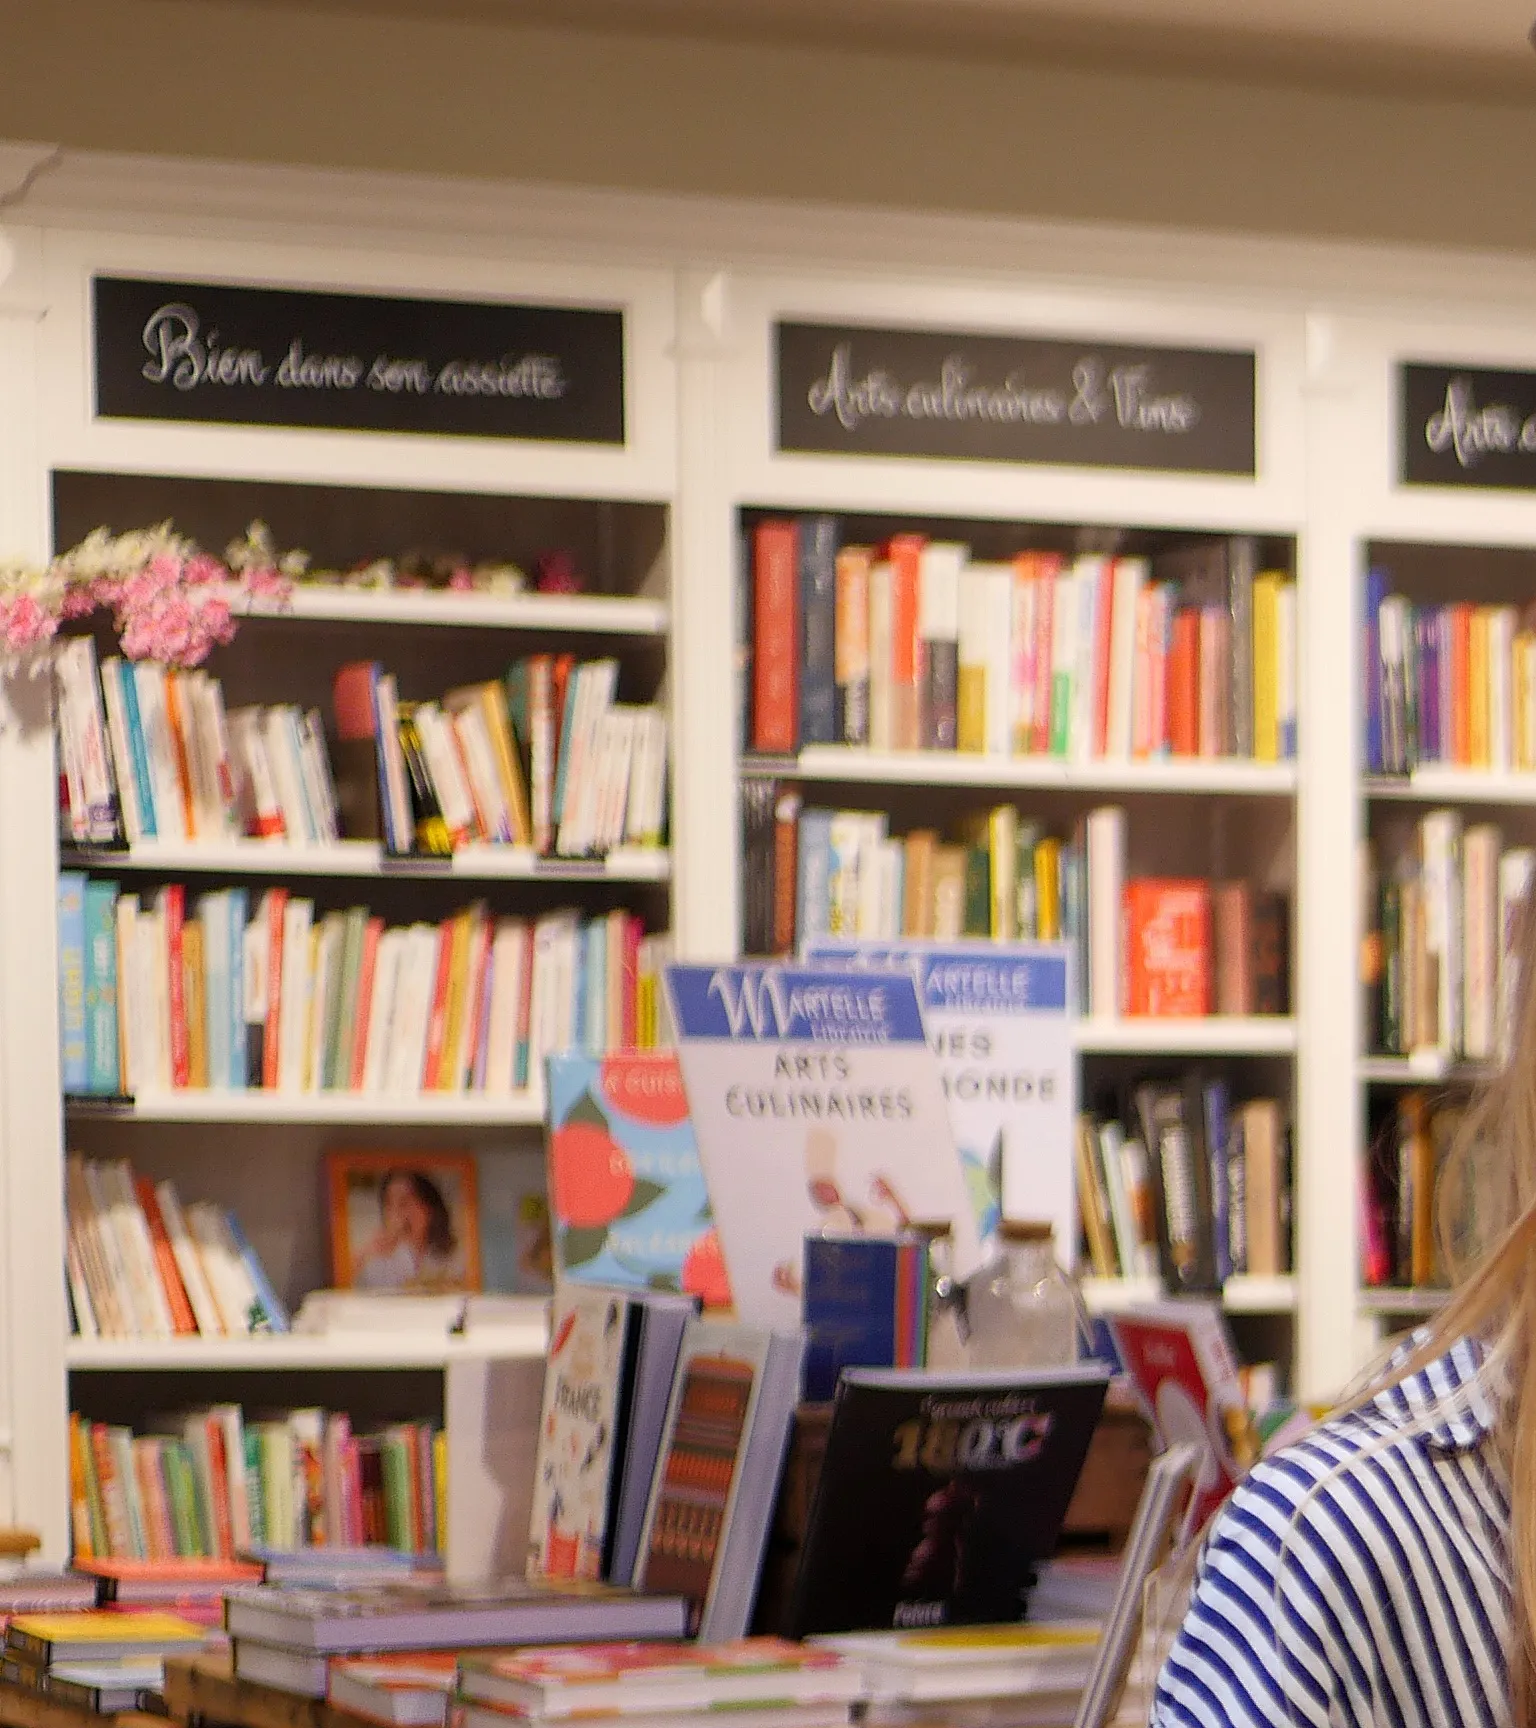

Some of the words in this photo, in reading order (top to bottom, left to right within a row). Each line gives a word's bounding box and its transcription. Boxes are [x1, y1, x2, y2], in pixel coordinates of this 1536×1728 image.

[142, 302, 270, 391] Bien
[274, 338, 364, 389] dans
[808, 341, 896, 431] Arts
[774, 1053, 851, 1080] ARTS
[725, 1084, 914, 1120] CULINAIRES
